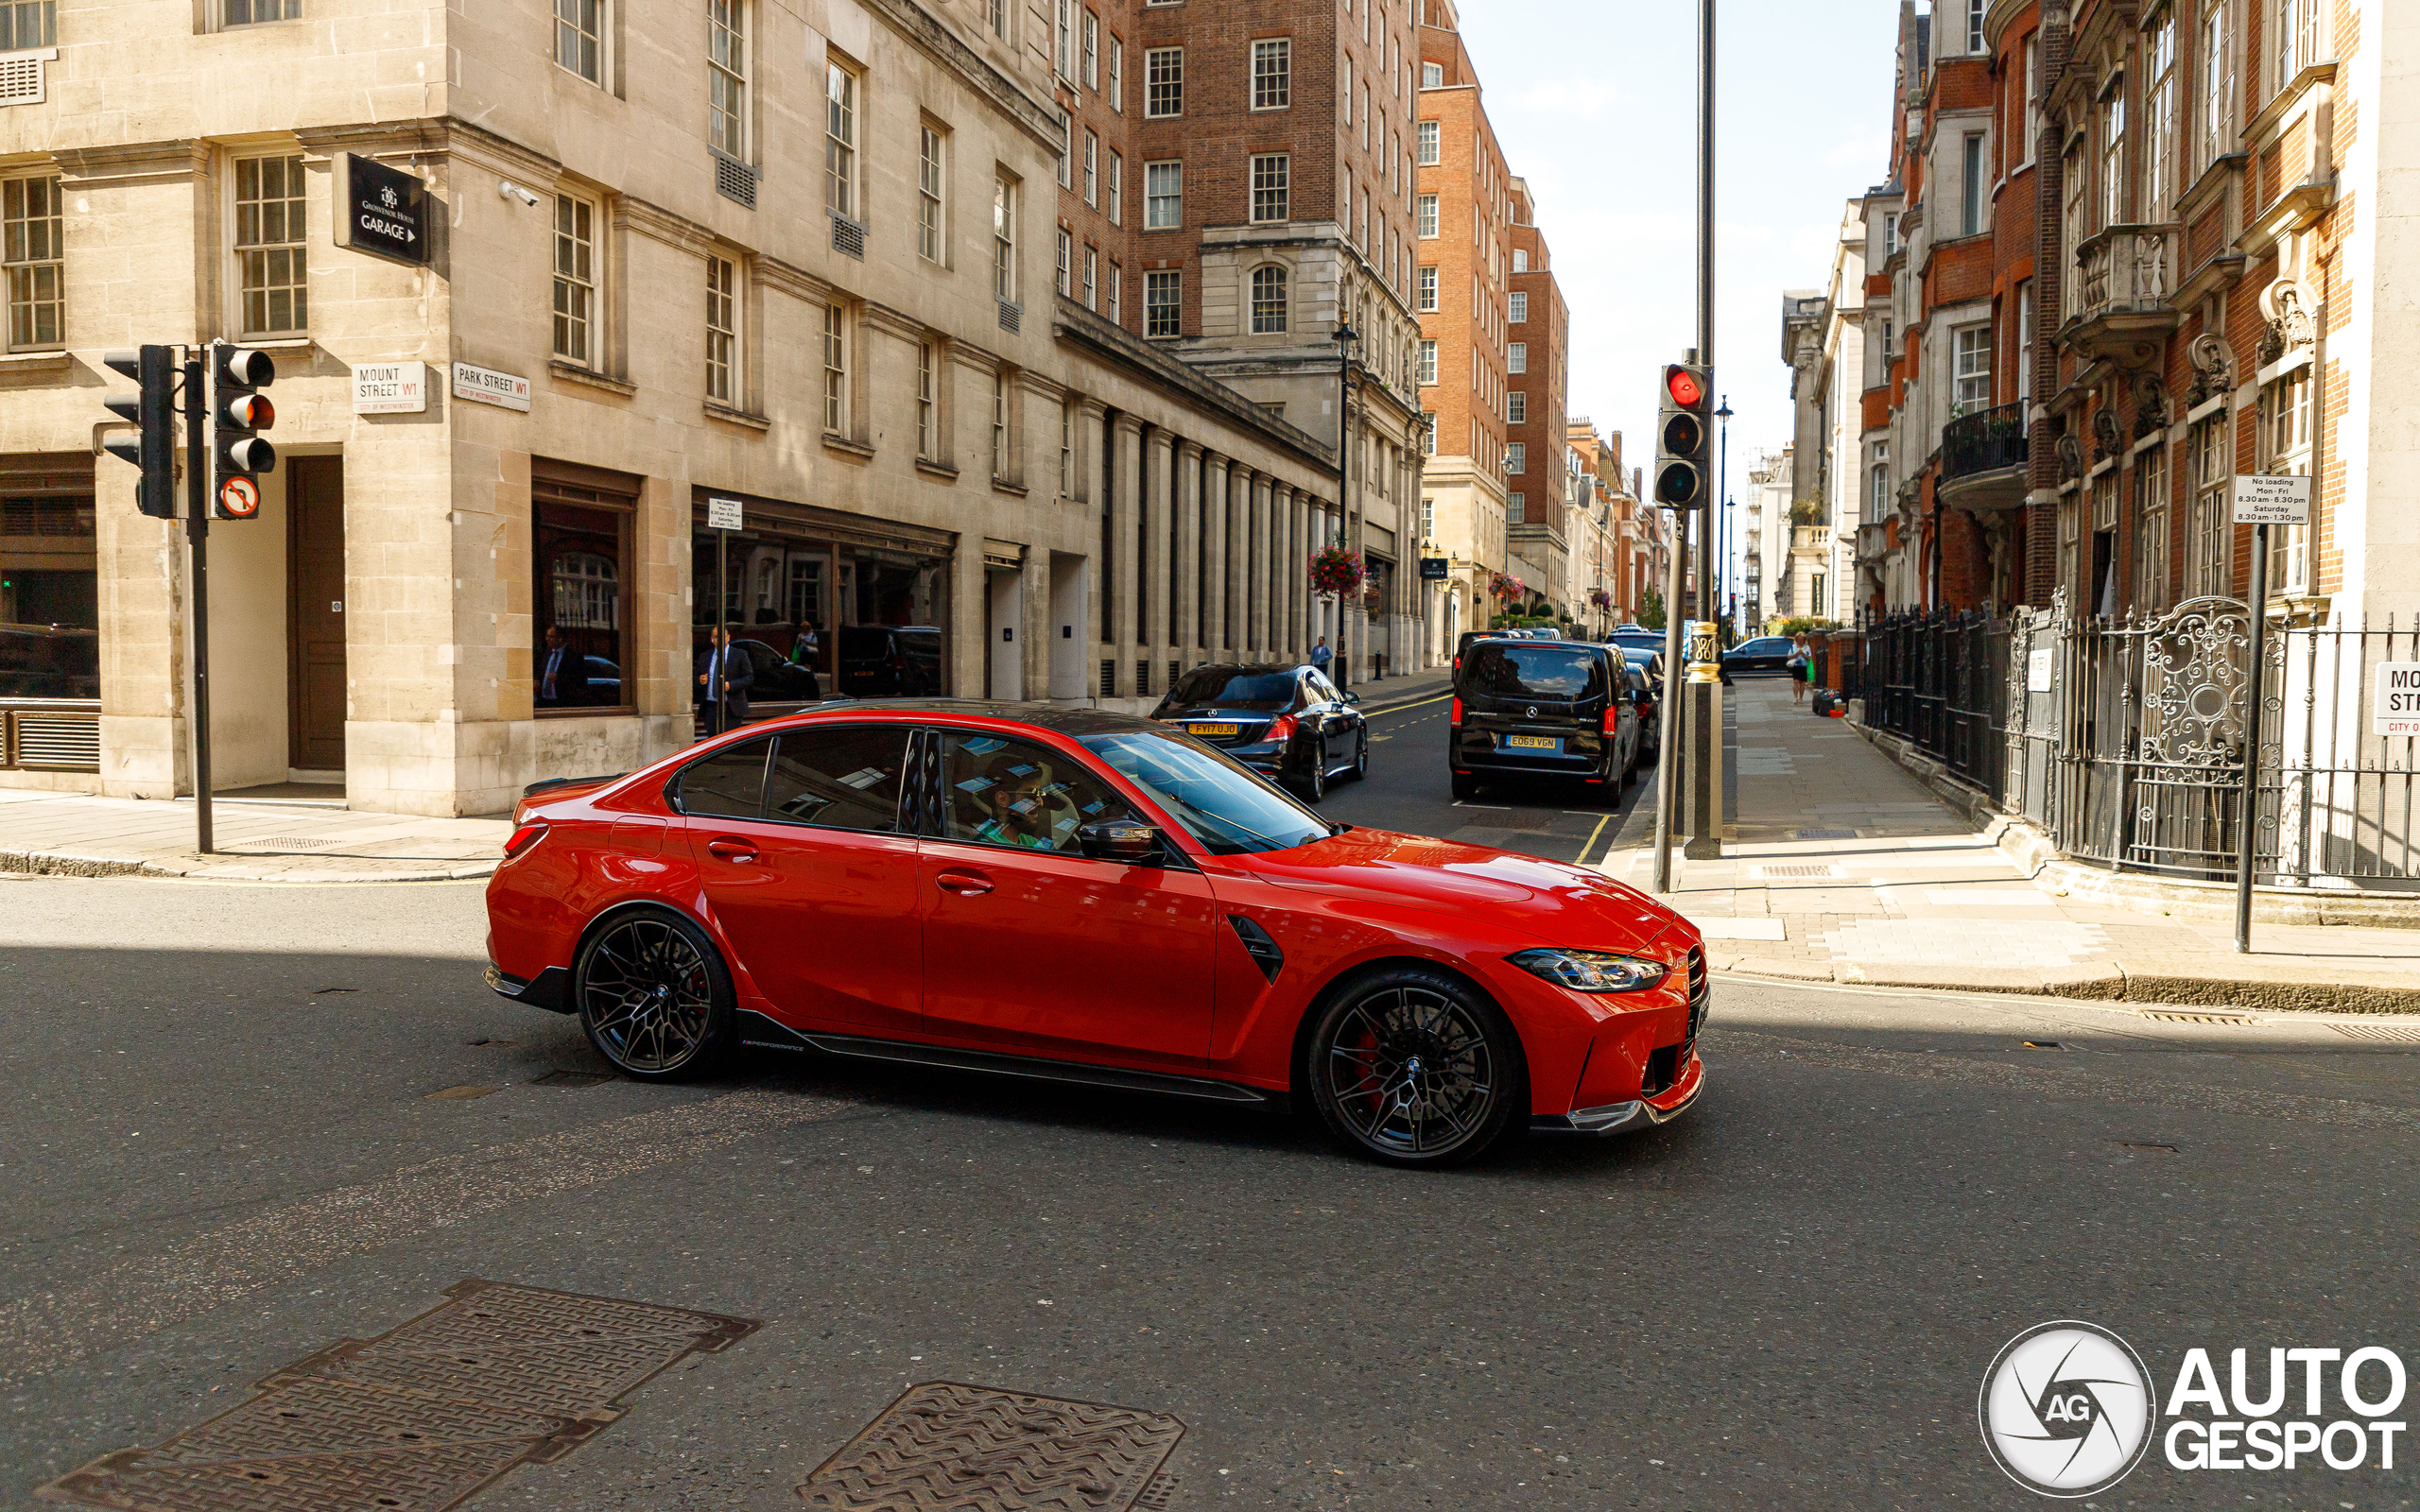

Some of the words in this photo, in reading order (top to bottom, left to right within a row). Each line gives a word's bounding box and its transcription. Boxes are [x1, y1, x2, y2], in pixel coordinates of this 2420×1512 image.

[362, 200, 397, 218] GROSVENOR
[397, 212, 414, 225] HOUSE
[361, 215, 405, 240] GARAGE
[360, 368, 400, 382] MOUNT
[459, 368, 482, 385] PARK
[484, 374, 513, 392] STREET
[515, 382, 527, 395] W1
[360, 384, 398, 397] STREET
[402, 383, 417, 395] W1
[475, 391, 502, 403] WESTMINSTER
[2391, 670, 2420, 688] MO
[2390, 693, 2420, 711] ST
[1218, 725, 1236, 733] UJO
[2389, 723, 2410, 731] CITY
[1512, 736, 1535, 746] EO69
[1537, 738, 1554, 747] VGN
